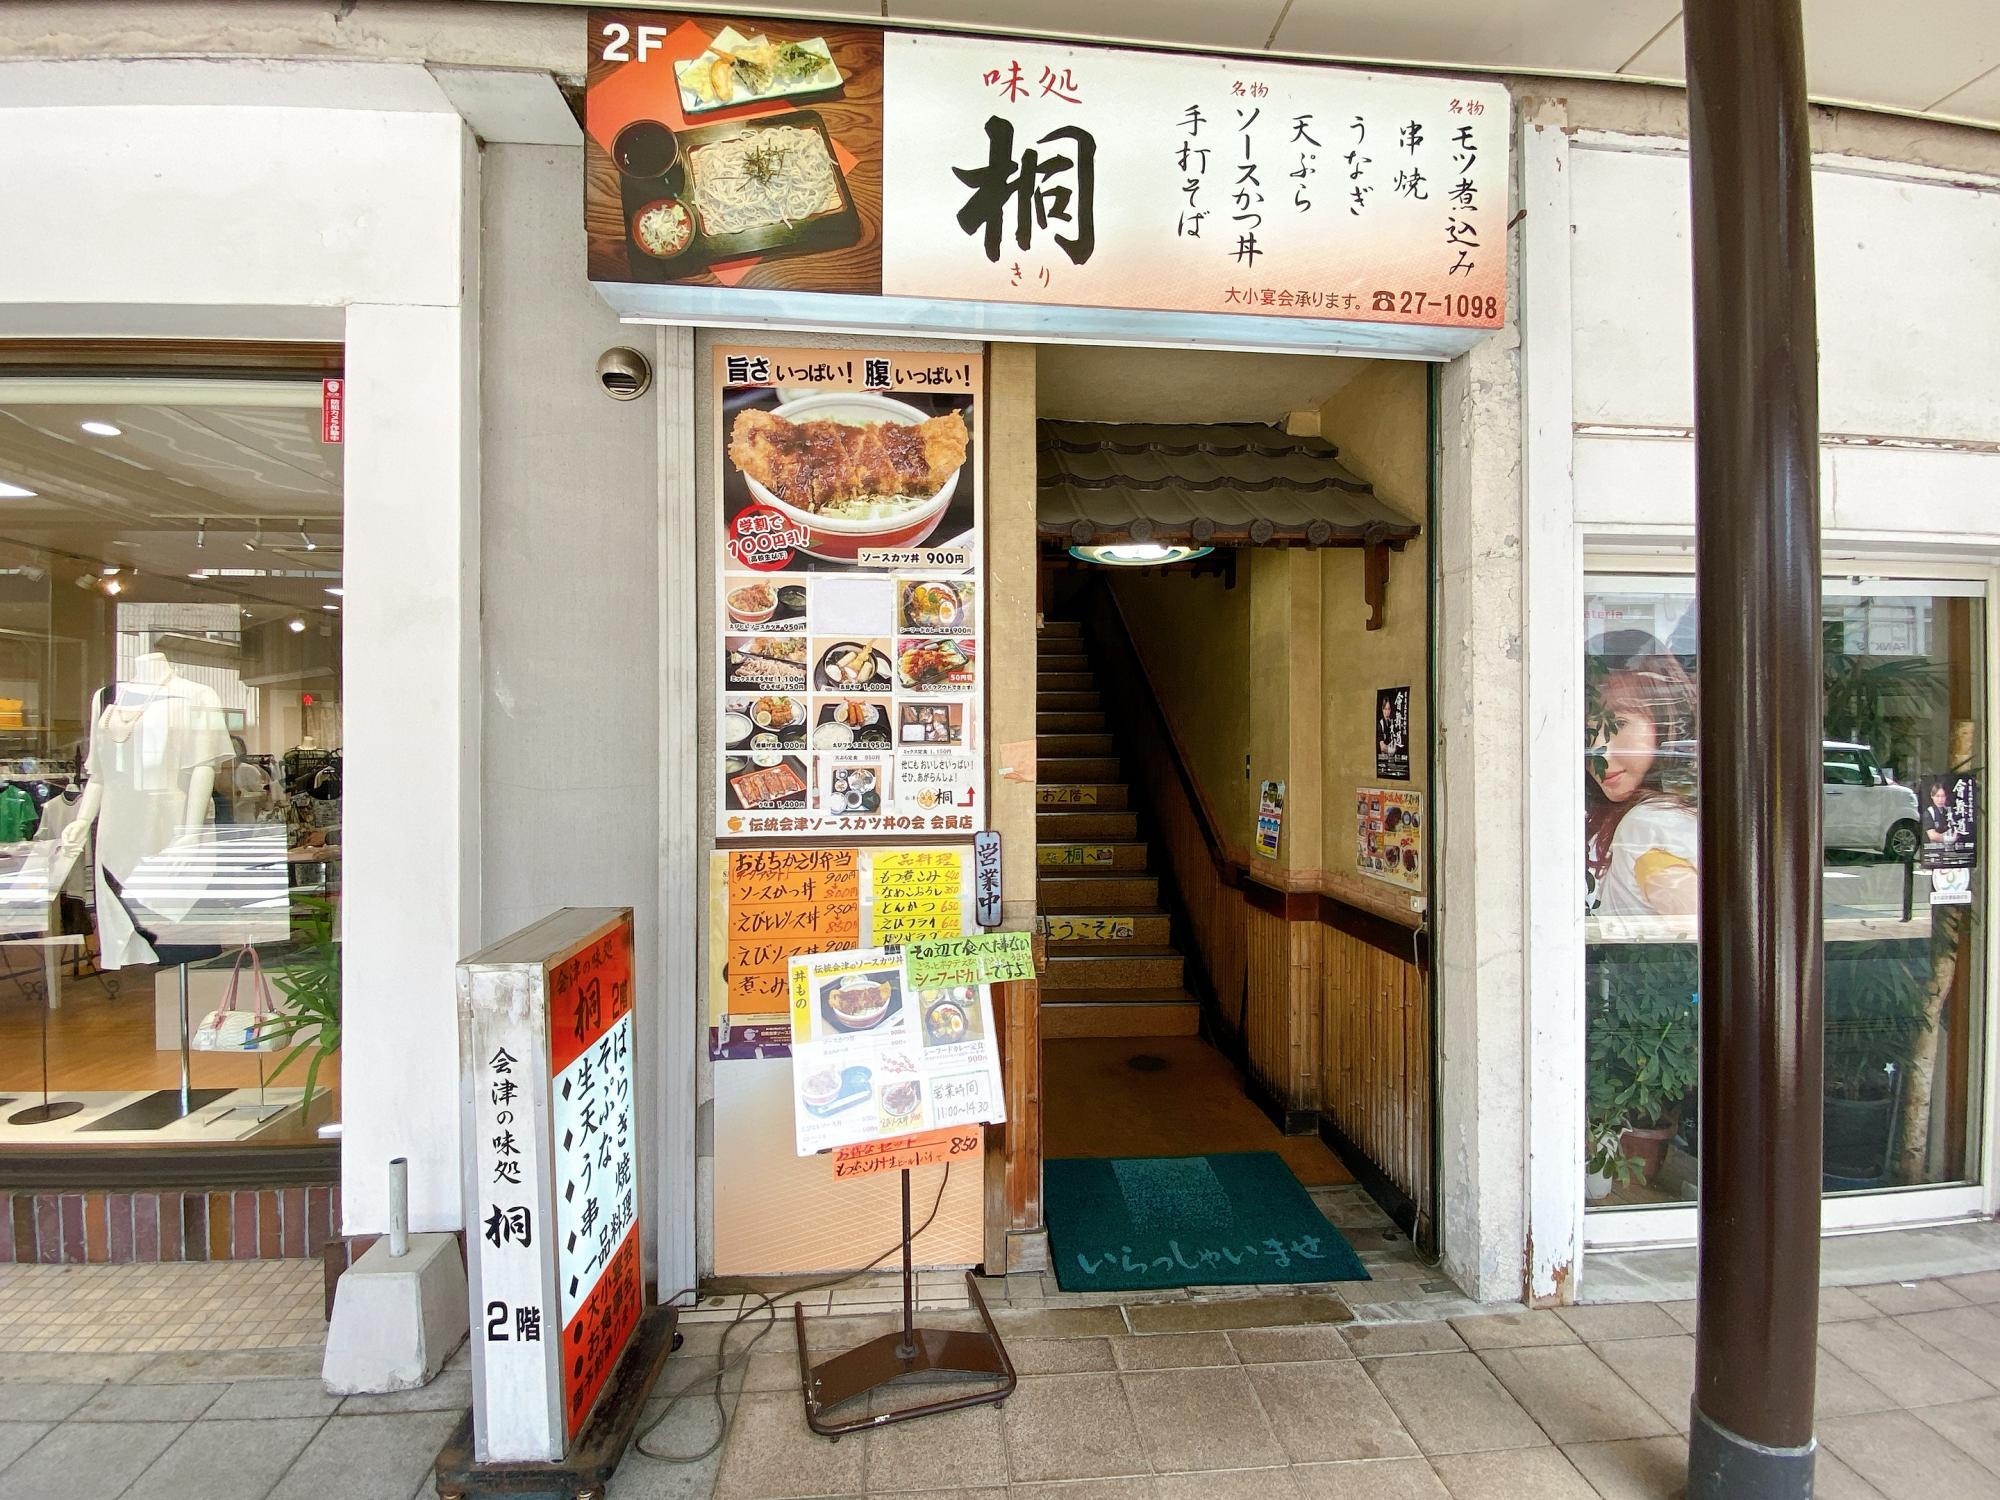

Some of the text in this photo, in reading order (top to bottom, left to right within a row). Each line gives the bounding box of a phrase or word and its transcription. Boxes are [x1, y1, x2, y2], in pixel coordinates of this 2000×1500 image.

[602, 23, 667, 63] 2F
[983, 60, 1082, 104] 味処
[1231, 80, 1269, 98] 名物
[1448, 98, 1485, 116] 名物
[1175, 104, 1211, 238] 手打そば
[1289, 114, 1322, 213] 天ぷら
[1343, 116, 1374, 215] うなぎ
[1393, 120, 1428, 201] 串焼
[952, 115, 1096, 265] 桐
[1228, 107, 1264, 268] ソースかつ丼
[1444, 125, 1480, 277] モツ煮込み
[1011, 262, 1049, 288] きり
[1224, 287, 1497, 318] 大小宴会承ります。 27-1098
[737, 512, 785, 535] 学割で
[861, 552, 964, 565] ソースカツ丼 900円
[934, 788, 953, 805] 桐
[749, 815, 973, 831] 伝統会津ソースカツ丼の会 会員店
[883, 853, 955, 866] 一品料理
[978, 843, 1000, 920] 営業中
[793, 970, 807, 1009] 丼もの
[486, 1046, 523, 1186] 会津の味処
[949, 1136, 978, 1154] 850
[485, 1204, 533, 1250] 桐
[1077, 1235, 1327, 1275] いらっしゃいませ
[486, 1299, 541, 1342] 2階
